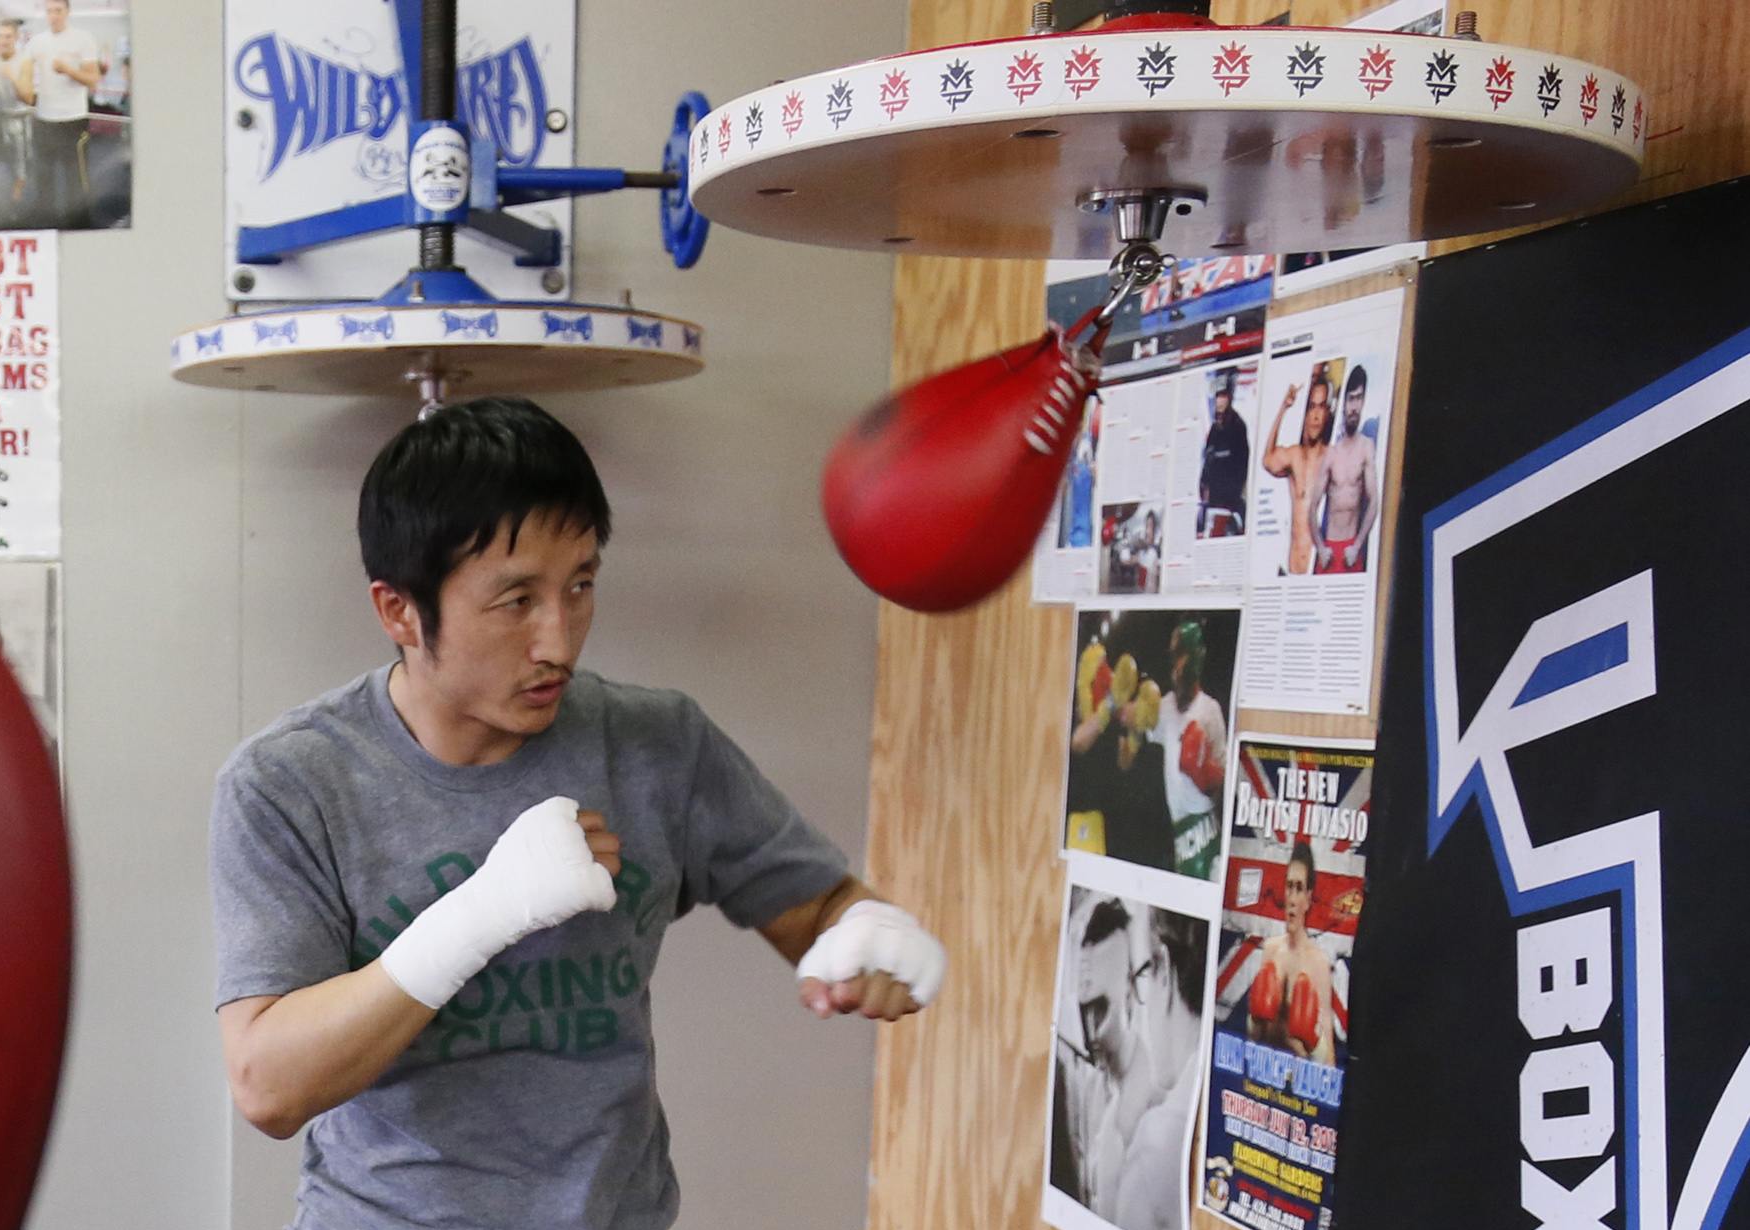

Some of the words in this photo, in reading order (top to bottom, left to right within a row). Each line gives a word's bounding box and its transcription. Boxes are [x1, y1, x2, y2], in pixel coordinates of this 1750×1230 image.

[1235, 781, 1301, 838] BRITISH
[1277, 766, 1307, 802] THE
[1307, 770, 1340, 804] NEW
[441, 1007, 619, 1062] CLUB
